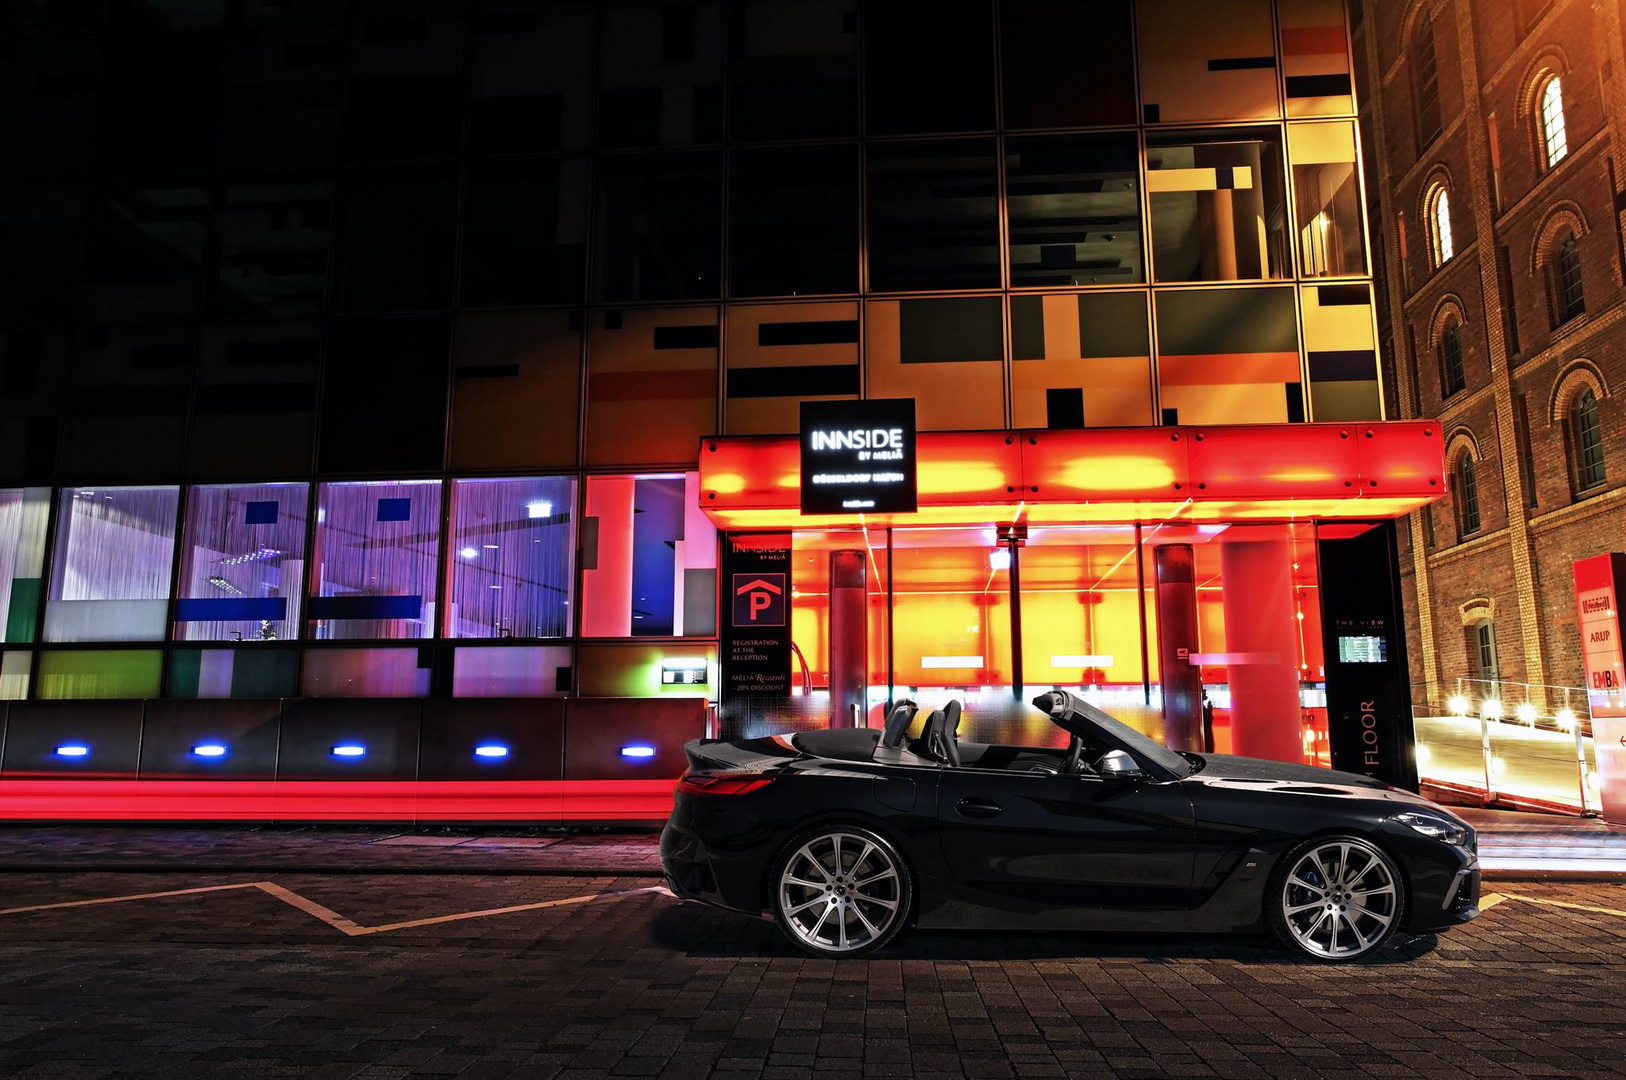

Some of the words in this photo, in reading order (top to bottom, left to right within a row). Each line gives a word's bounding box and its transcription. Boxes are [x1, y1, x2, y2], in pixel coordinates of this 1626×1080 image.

[811, 429, 903, 450] INNSIDE
[858, 451, 871, 461] BY
[750, 591, 771, 621] P
[1590, 630, 1610, 643] ARUP
[1592, 670, 1620, 688] EMBA
[1360, 700, 1379, 765] FLOOR
